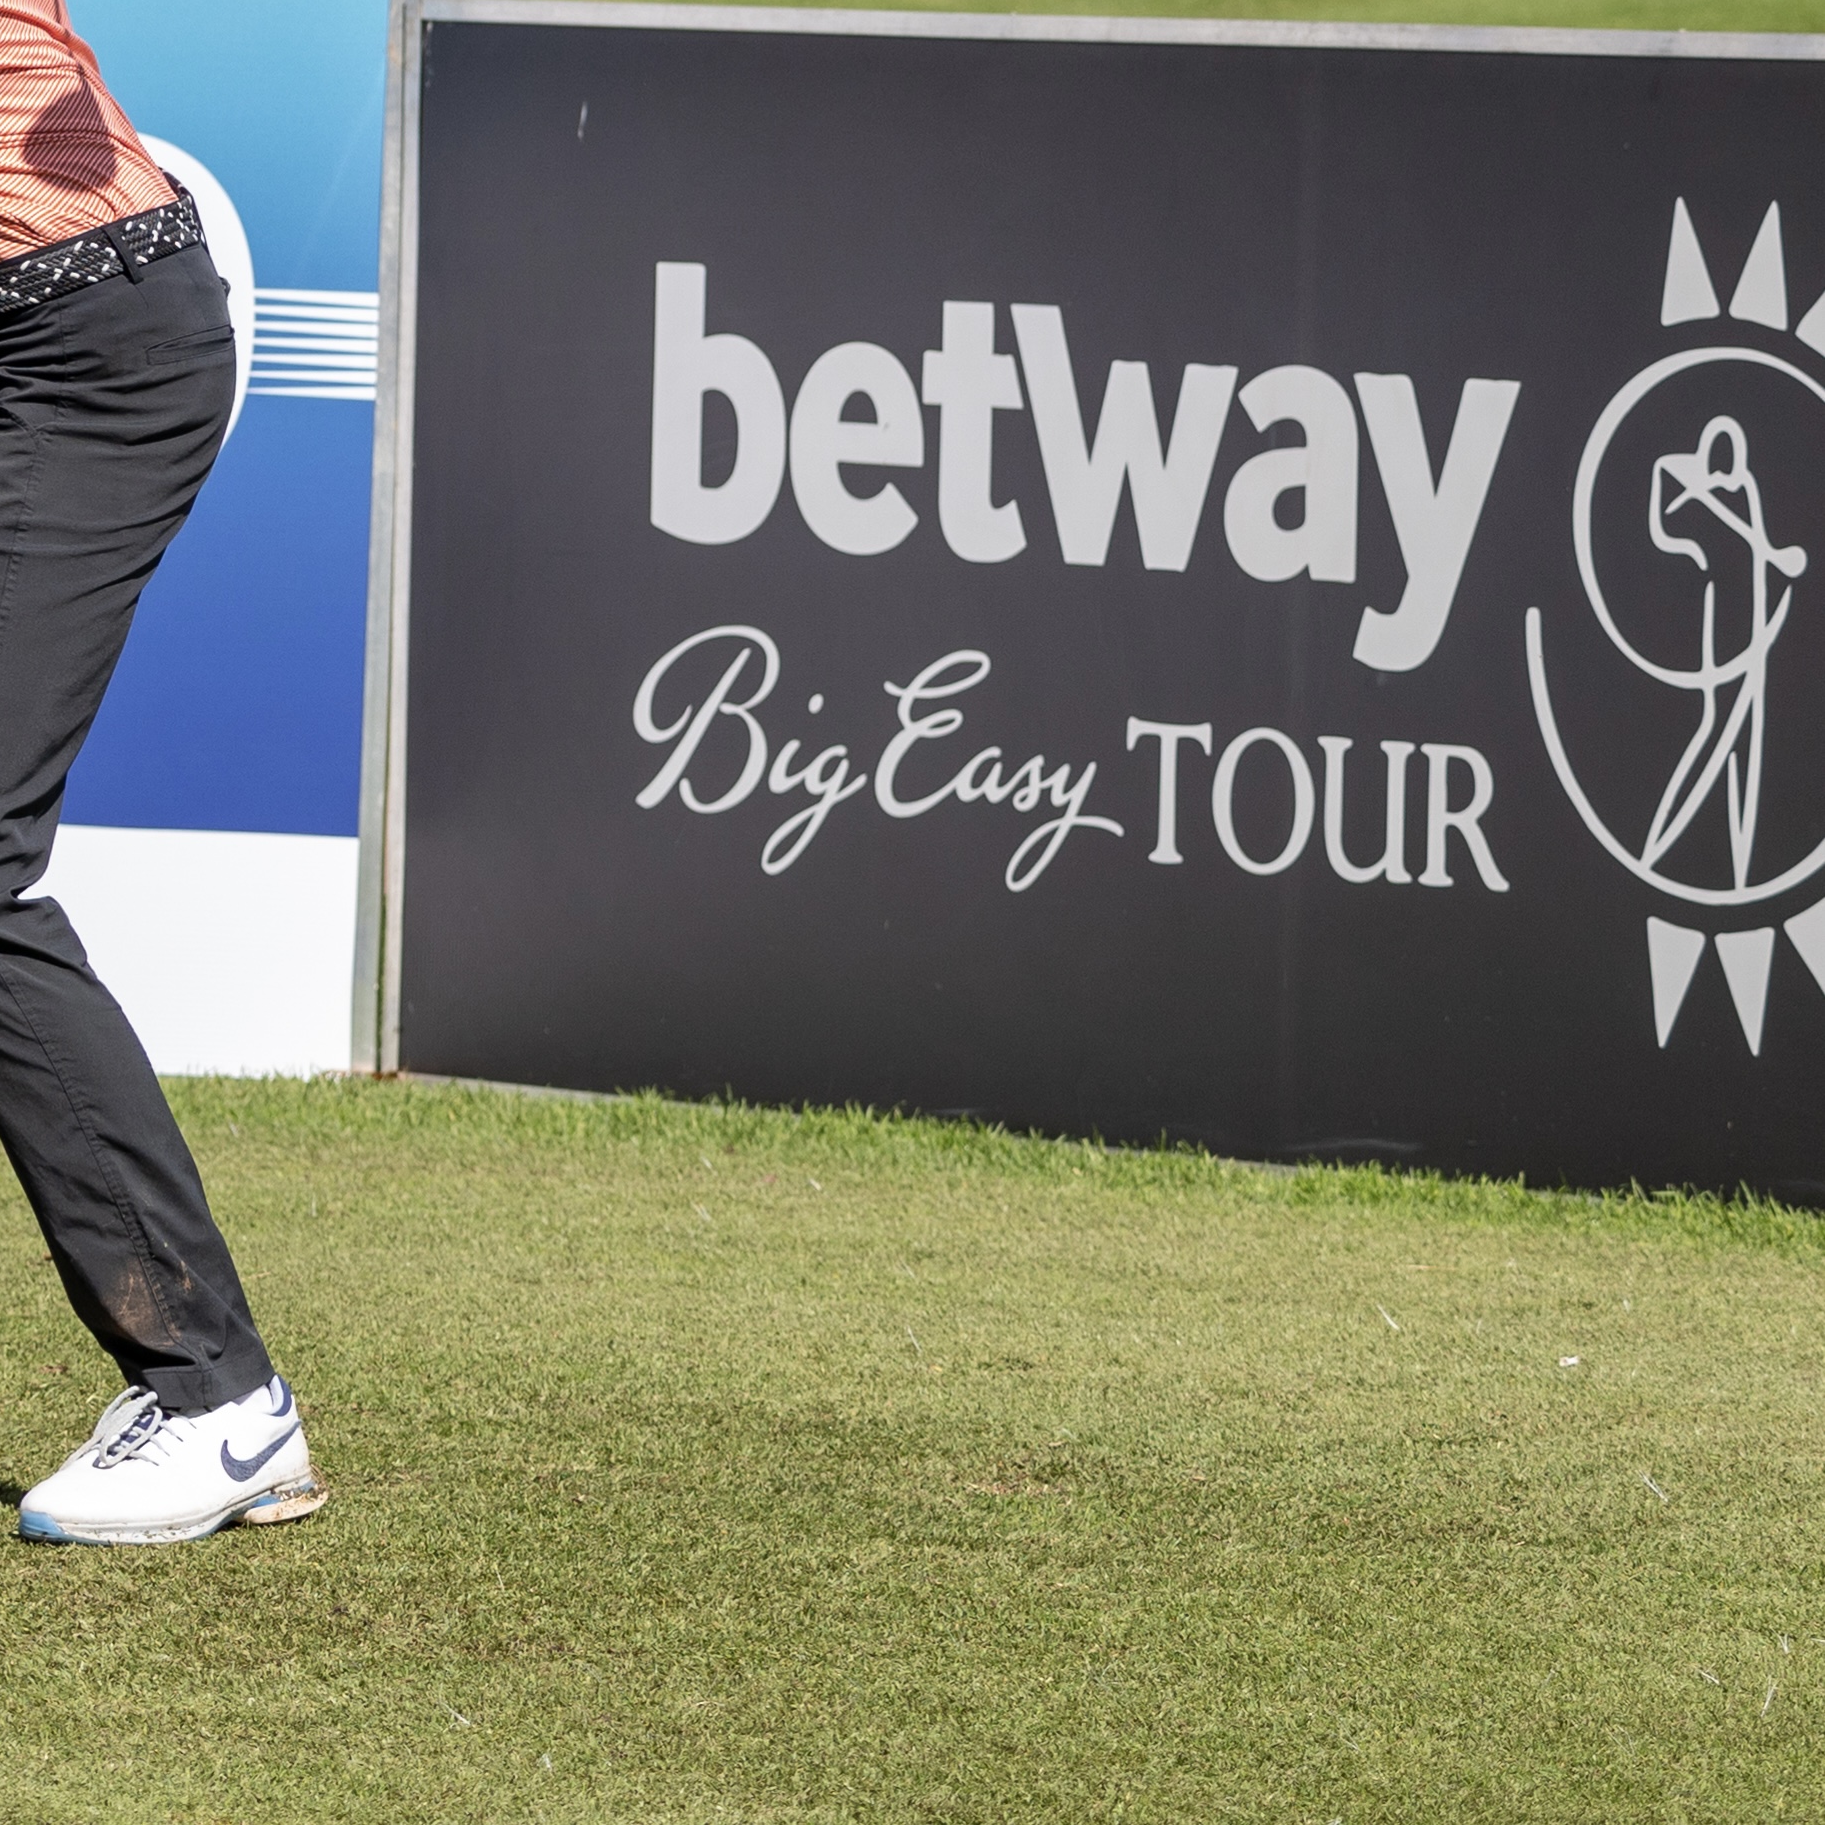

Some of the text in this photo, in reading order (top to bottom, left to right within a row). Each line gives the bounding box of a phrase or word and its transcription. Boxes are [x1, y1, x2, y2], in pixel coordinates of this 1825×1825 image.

[650, 261, 1521, 672] betway
[632, 625, 1510, 892] Big Easy TOUR
